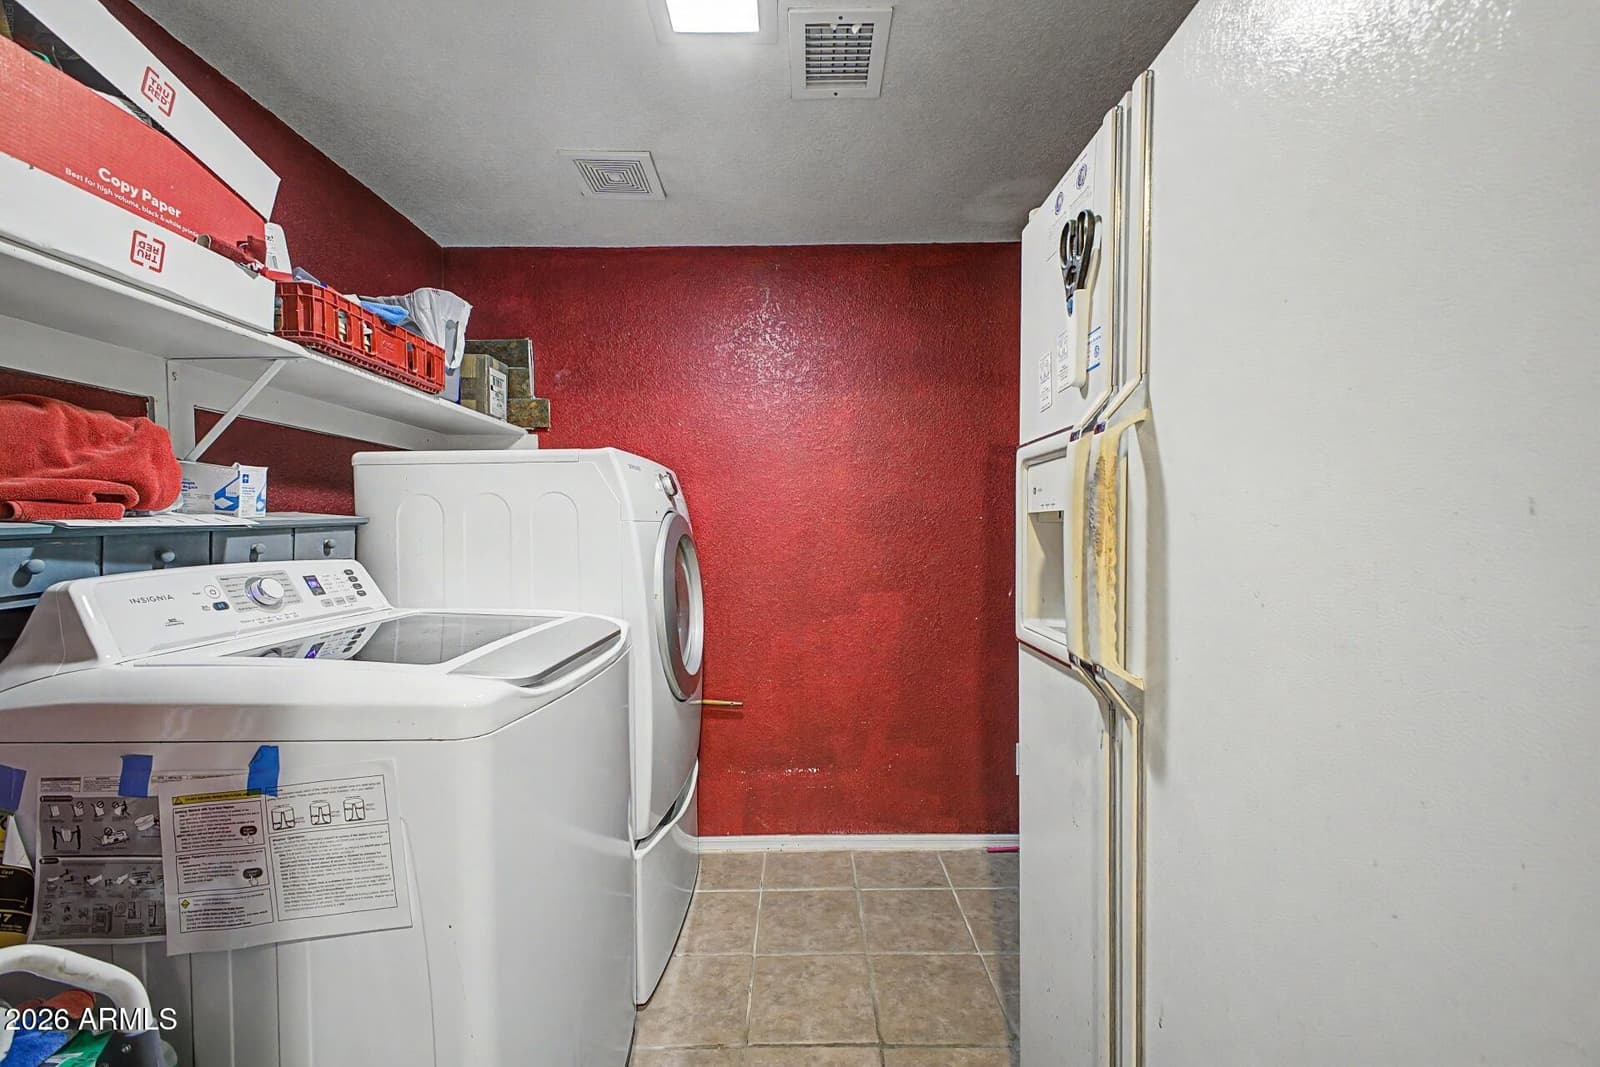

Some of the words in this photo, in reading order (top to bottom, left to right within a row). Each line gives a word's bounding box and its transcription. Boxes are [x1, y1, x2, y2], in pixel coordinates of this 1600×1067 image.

[148, 84, 167, 105] RED
[150, 76, 170, 98] TRU
[65, 167, 83, 182] Best
[85, 177, 96, 187] for
[97, 183, 113, 196] high
[114, 193, 141, 211] volume,
[142, 205, 159, 219] black
[98, 167, 139, 198] Copy
[141, 188, 182, 218] Paper
[137, 249, 158, 264] TRU
[138, 240, 159, 255] RED
[129, 594, 175, 604] INSIGNIA
